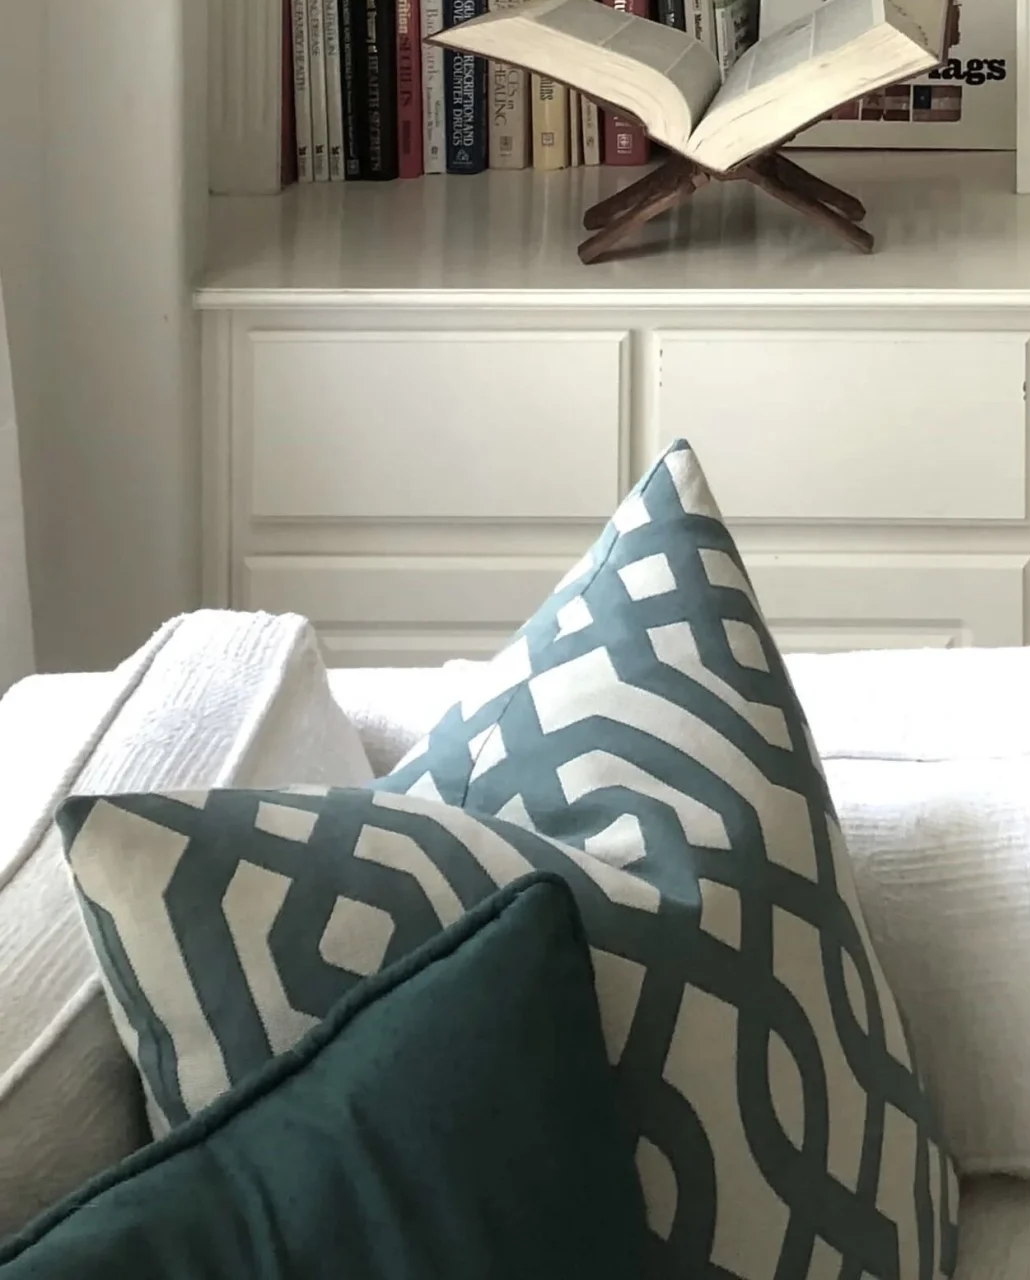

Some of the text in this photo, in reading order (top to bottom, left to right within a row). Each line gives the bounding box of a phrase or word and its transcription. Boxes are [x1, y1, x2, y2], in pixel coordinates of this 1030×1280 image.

[295, 49, 307, 91] HEALTH
[368, 55, 379, 108] HEALTH
[399, 35, 413, 108] SECRETS
[493, 63, 508, 127] HEALING
[452, 108, 464, 148] DRUGS
[463, 55, 475, 148] RESCRIPTION AND
[507, 99, 517, 110] in
[369, 110, 381, 172] SECRETS
